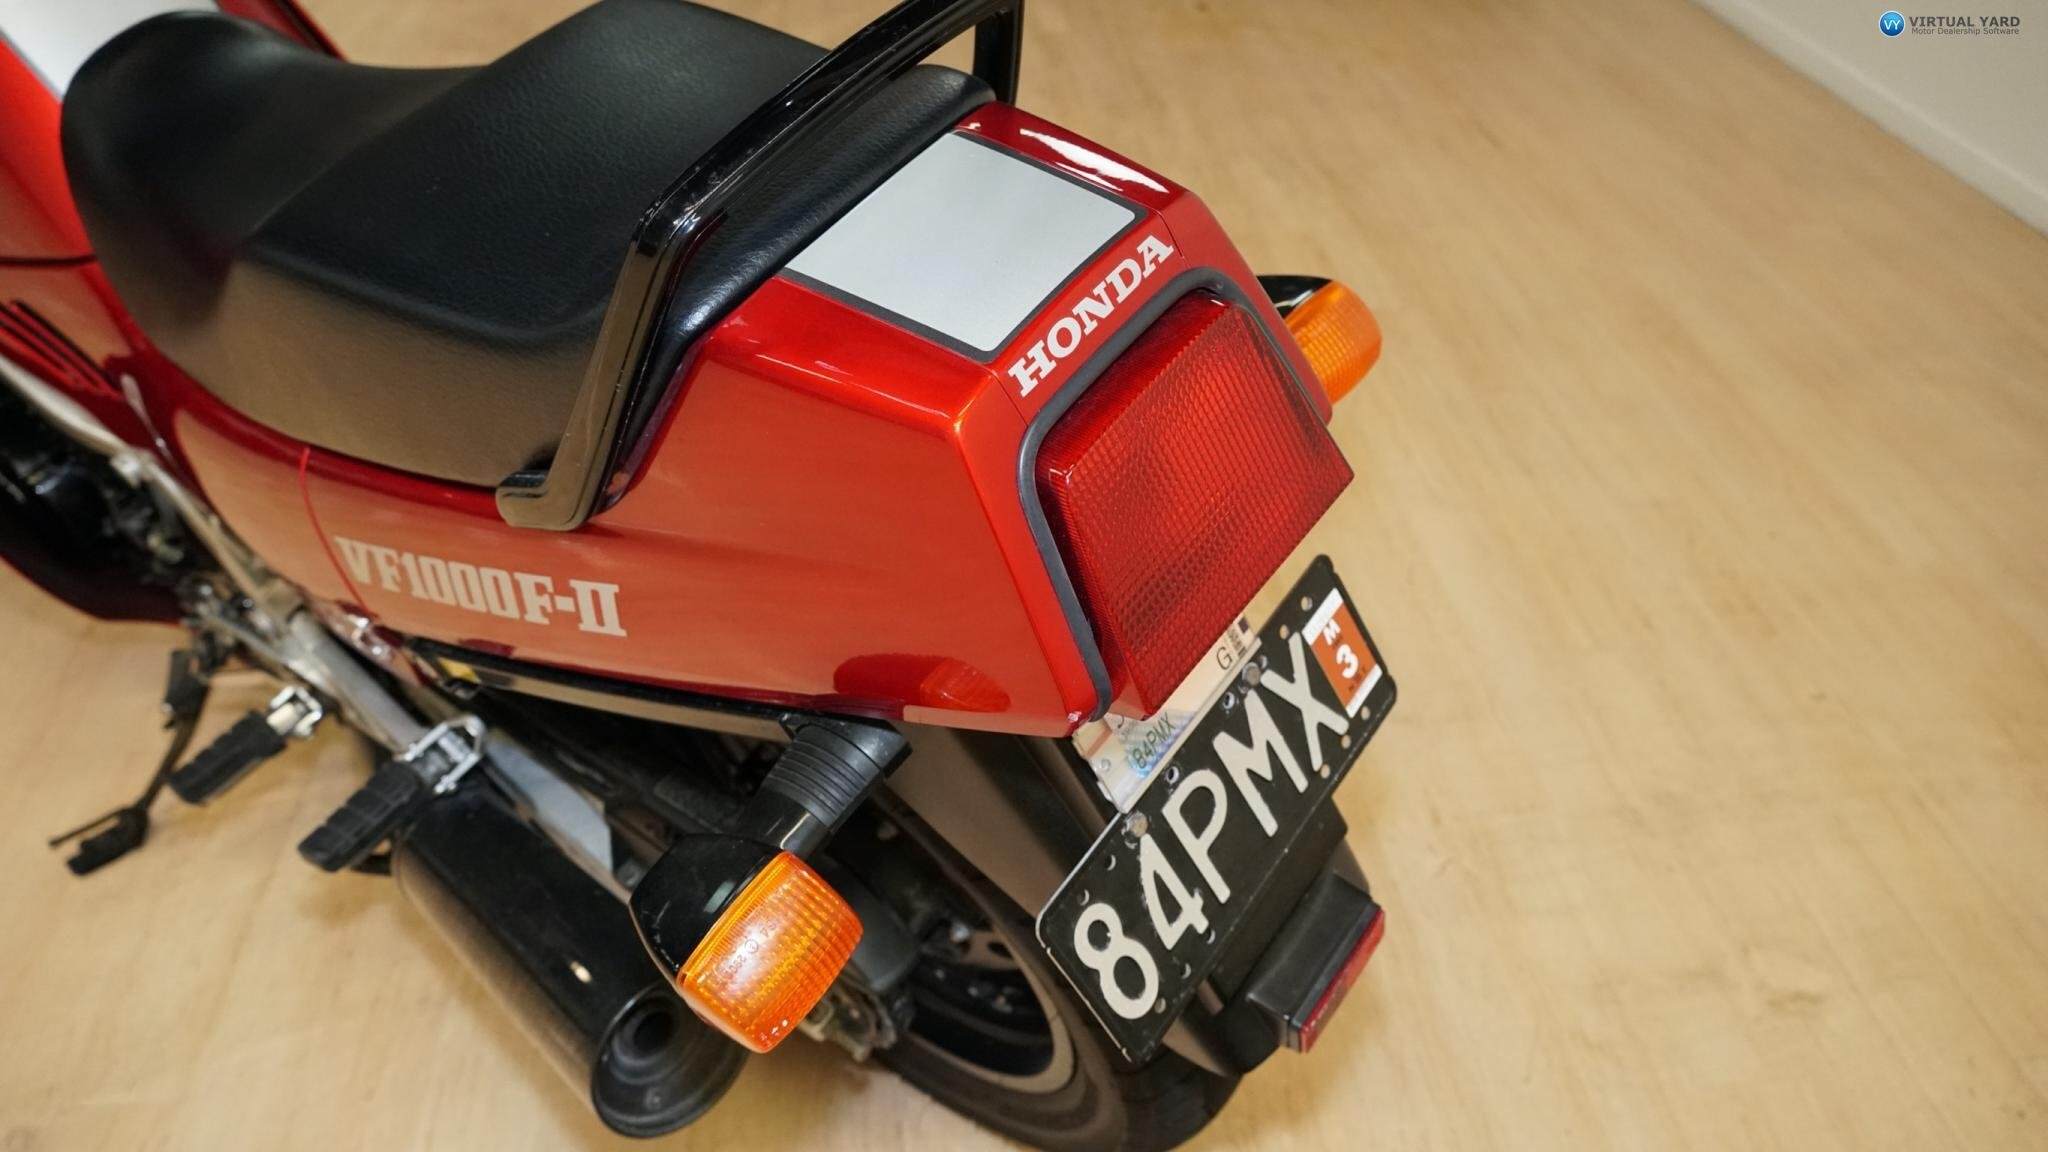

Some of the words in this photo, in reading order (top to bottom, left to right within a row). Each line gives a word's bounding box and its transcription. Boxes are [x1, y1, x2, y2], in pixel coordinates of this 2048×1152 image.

[1008, 235, 1174, 397] HONDA
[1336, 644, 1359, 679] 3
[1132, 712, 1176, 769] 84PMX
[1073, 632, 1349, 1020] 84PMX
